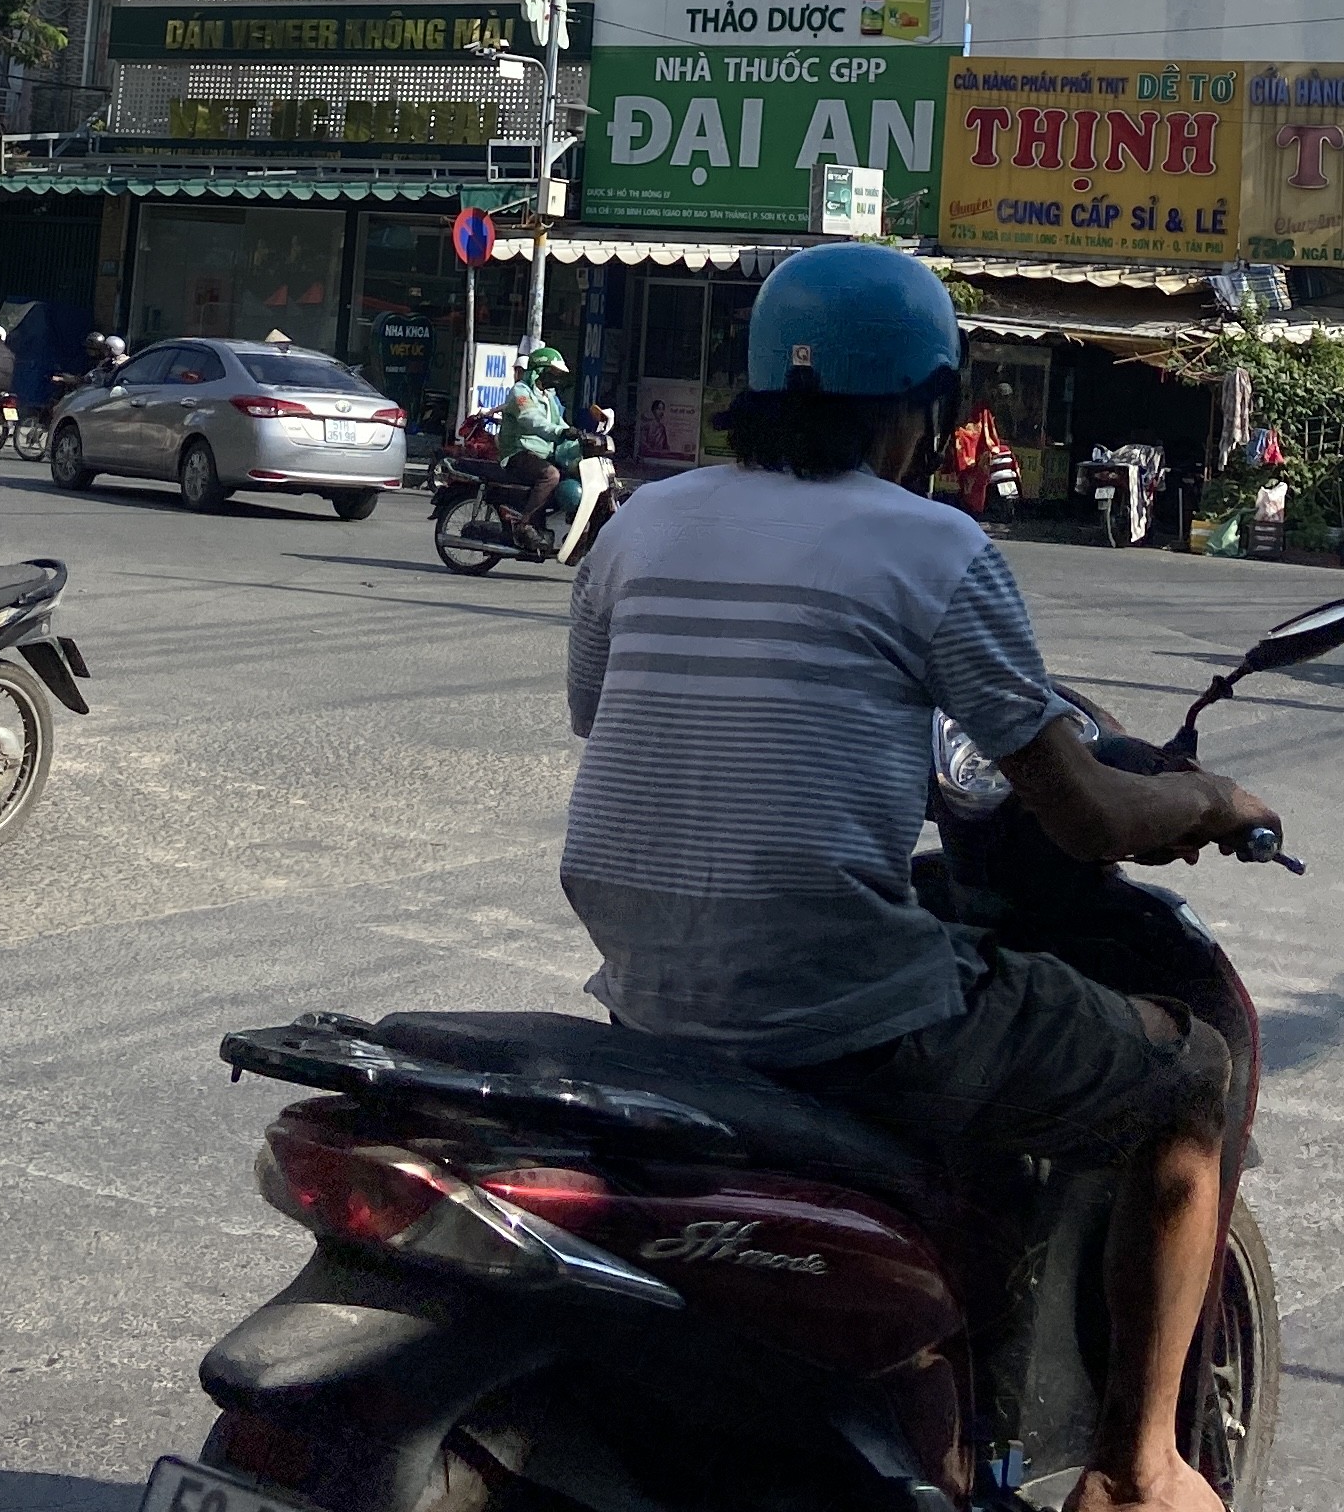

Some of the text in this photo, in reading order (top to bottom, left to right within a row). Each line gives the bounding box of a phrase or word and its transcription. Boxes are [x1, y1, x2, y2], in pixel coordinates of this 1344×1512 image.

[166, 9, 515, 50] DÁN VENEER KHÔNG MÀI
[686, 0, 846, 39] THẢO DƯỢC
[655, 49, 887, 83] NHÀ THUỐC GPP
[953, 64, 1238, 104] CỬA HÀNG PHÂN PHỐI THỊT DÊ TƠ
[1250, 65, 1289, 107] CỬA
[607, 95, 935, 186] ĐẠI AN
[965, 106, 1221, 192] THỊNH
[997, 198, 1063, 227] CUNG
[1071, 195, 1121, 231] CẤP
[1165, 207, 1184, 233] &
[1196, 199, 1228, 235] LẺ
[1301, 244, 1328, 261] NGÃ
[385, 324, 430, 338] NHA KHOA
[486, 352, 507, 378] NHÀ
